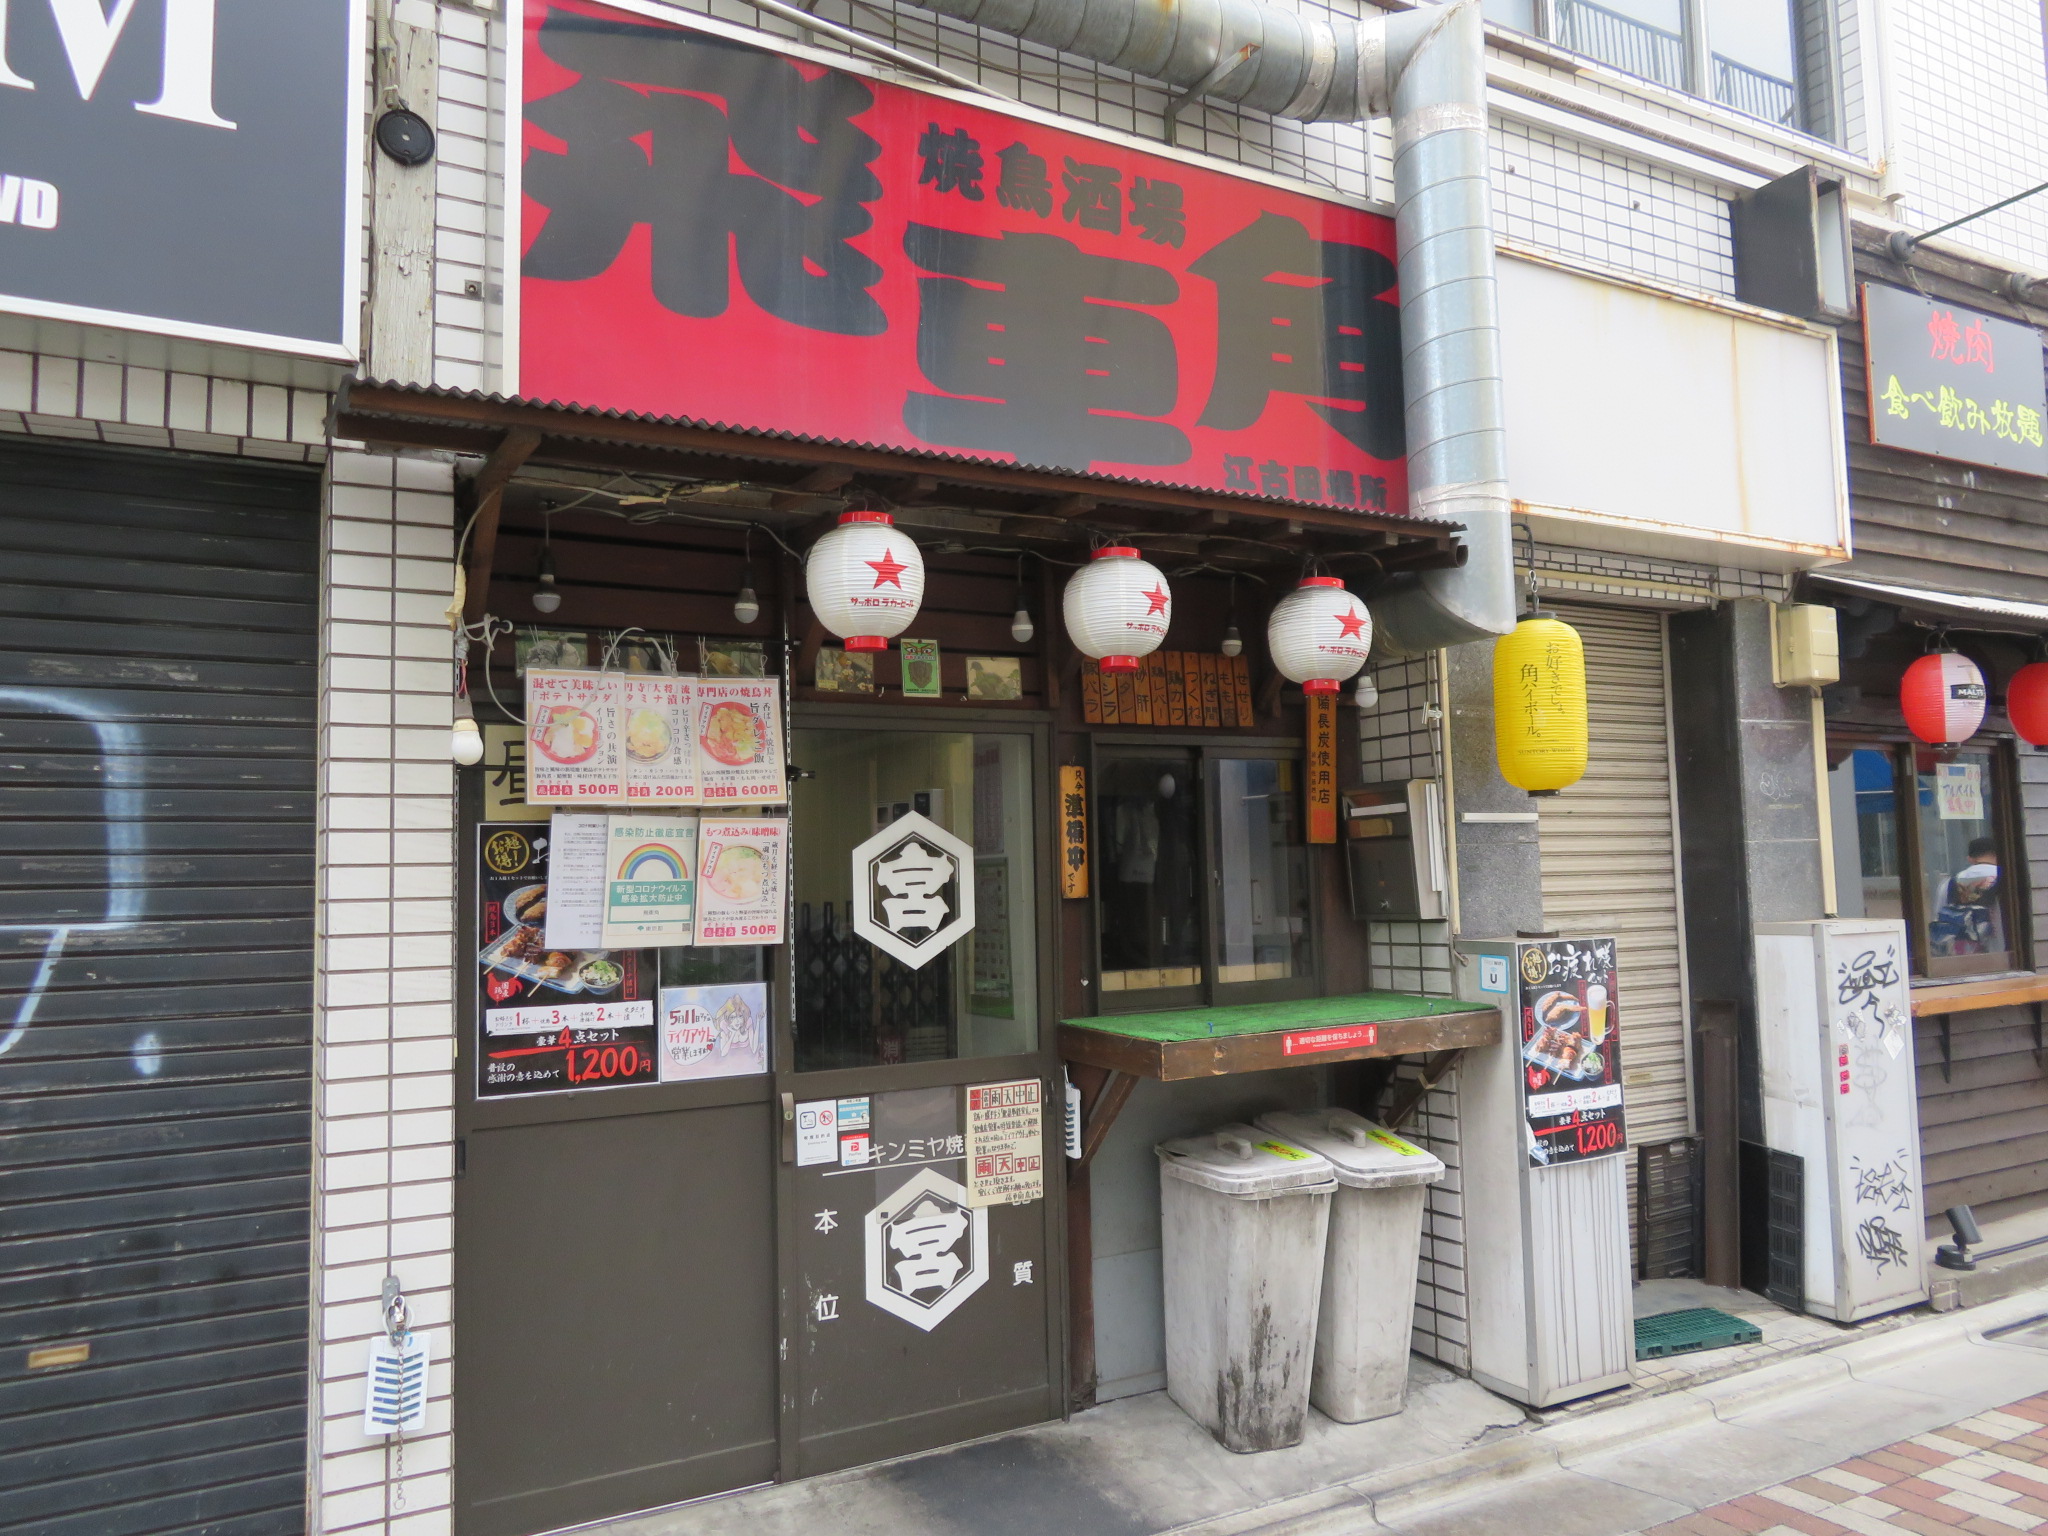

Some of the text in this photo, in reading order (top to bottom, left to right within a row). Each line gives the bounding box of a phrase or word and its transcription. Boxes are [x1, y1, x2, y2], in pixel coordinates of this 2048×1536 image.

[918, 122, 1187, 250] 焼鳥酒場
[1928, 310, 1994, 374] 焼肉
[1881, 373, 2044, 448] 食べ飲み放題
[1223, 452, 1388, 511] 江古田場所
[850, 597, 880, 608] サッポロ
[1126, 621, 1150, 632] サッポロ
[1318, 644, 1344, 655] サッポロ
[532, 677, 618, 691] 混ぜて美味しい
[1116, 671, 1134, 714] タン
[1185, 671, 1202, 720] つくね
[1203, 671, 1219, 721] ねぎ間
[1236, 674, 1251, 721] せせり
[1519, 662, 1542, 739] 角ハイボール。
[578, 784, 619, 796] 500円
[655, 785, 695, 797] 200円
[741, 784, 779, 796] 600円
[614, 826, 695, 838] 感染防止徹底宣言
[1064, 792, 1085, 873] 準備中
[616, 883, 688, 894] 新型コロナウイルス
[1067, 871, 1076, 894] です
[621, 894, 683, 904] 感染拡大防止中
[740, 924, 777, 936] 500円
[868, 1135, 968, 1164] キンミヤ焼
